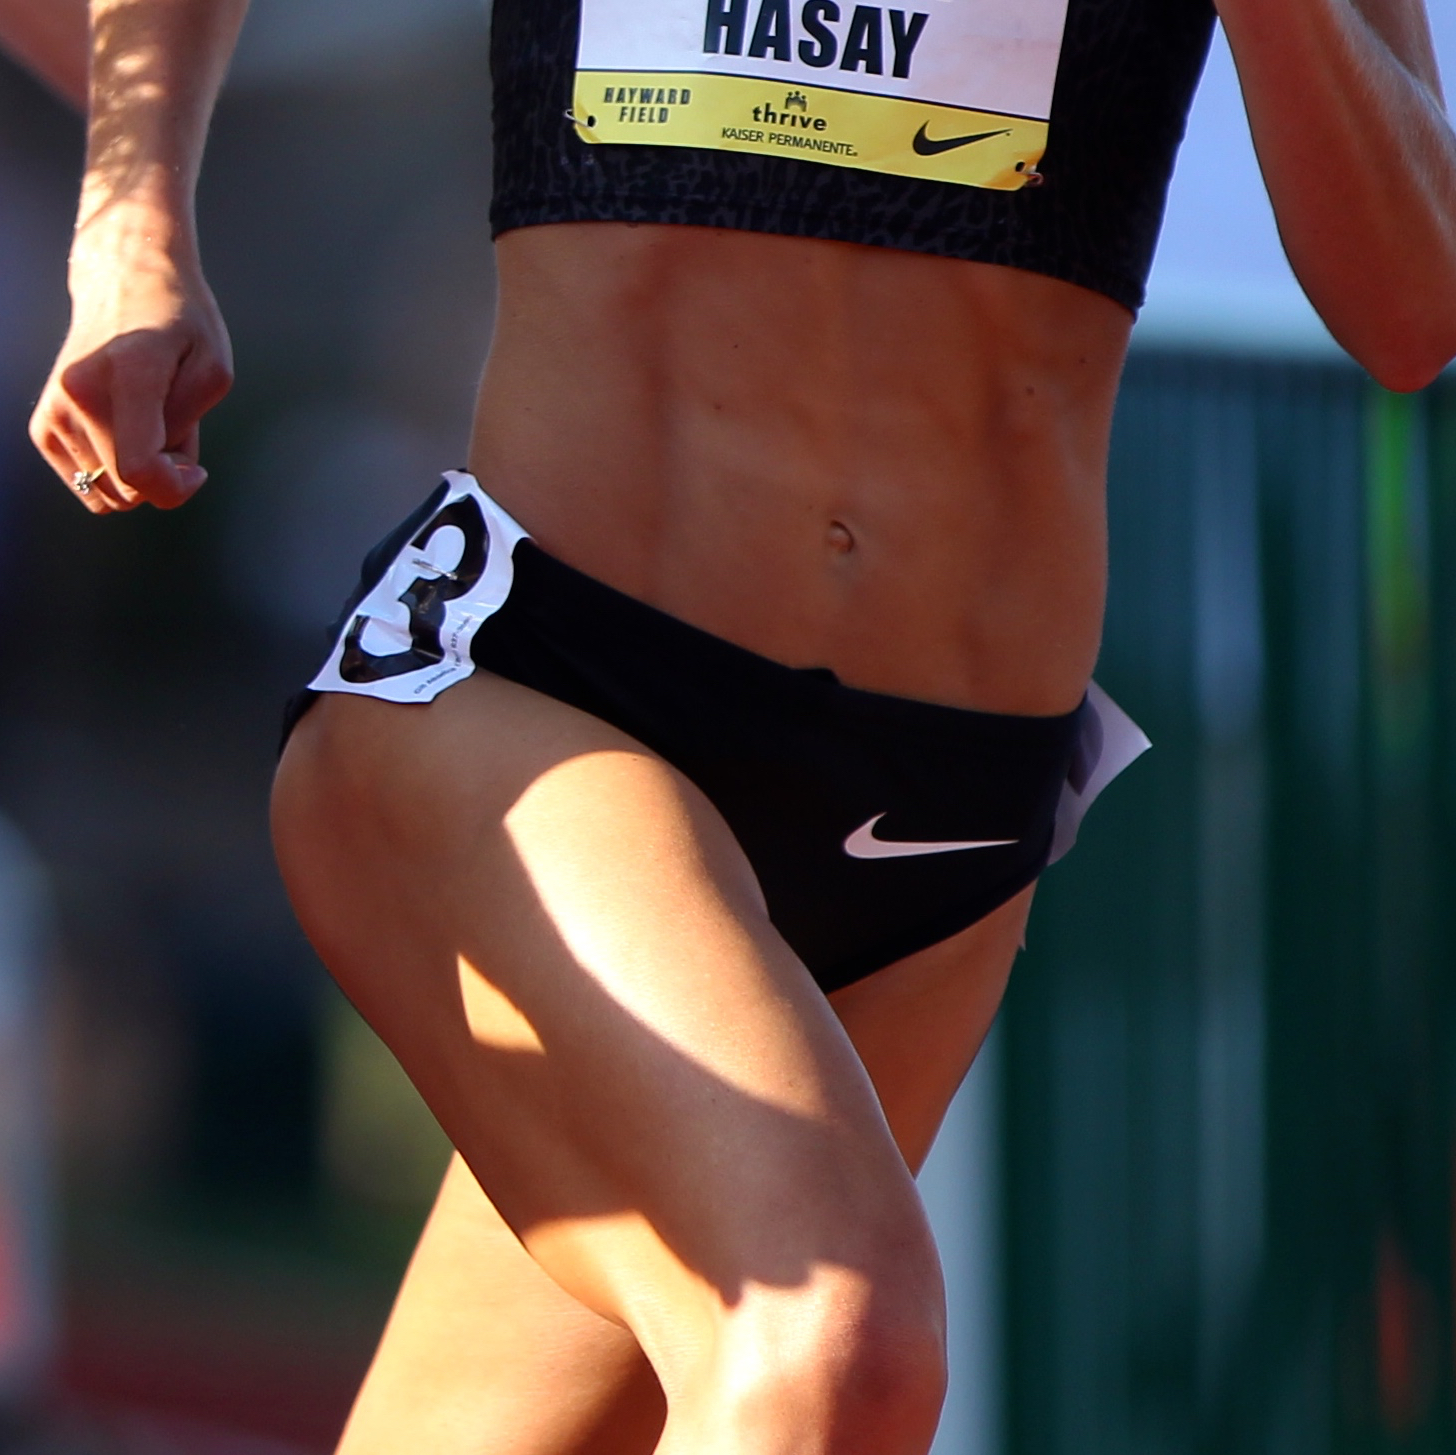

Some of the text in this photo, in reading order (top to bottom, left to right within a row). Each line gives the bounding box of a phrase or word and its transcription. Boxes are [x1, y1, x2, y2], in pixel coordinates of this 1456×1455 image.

[603, 87, 691, 106] HAYWARD
[619, 106, 669, 124] FIELD
[752, 102, 828, 132] thrive
[722, 127, 764, 144] KAISER
[339, 493, 490, 684] 3
